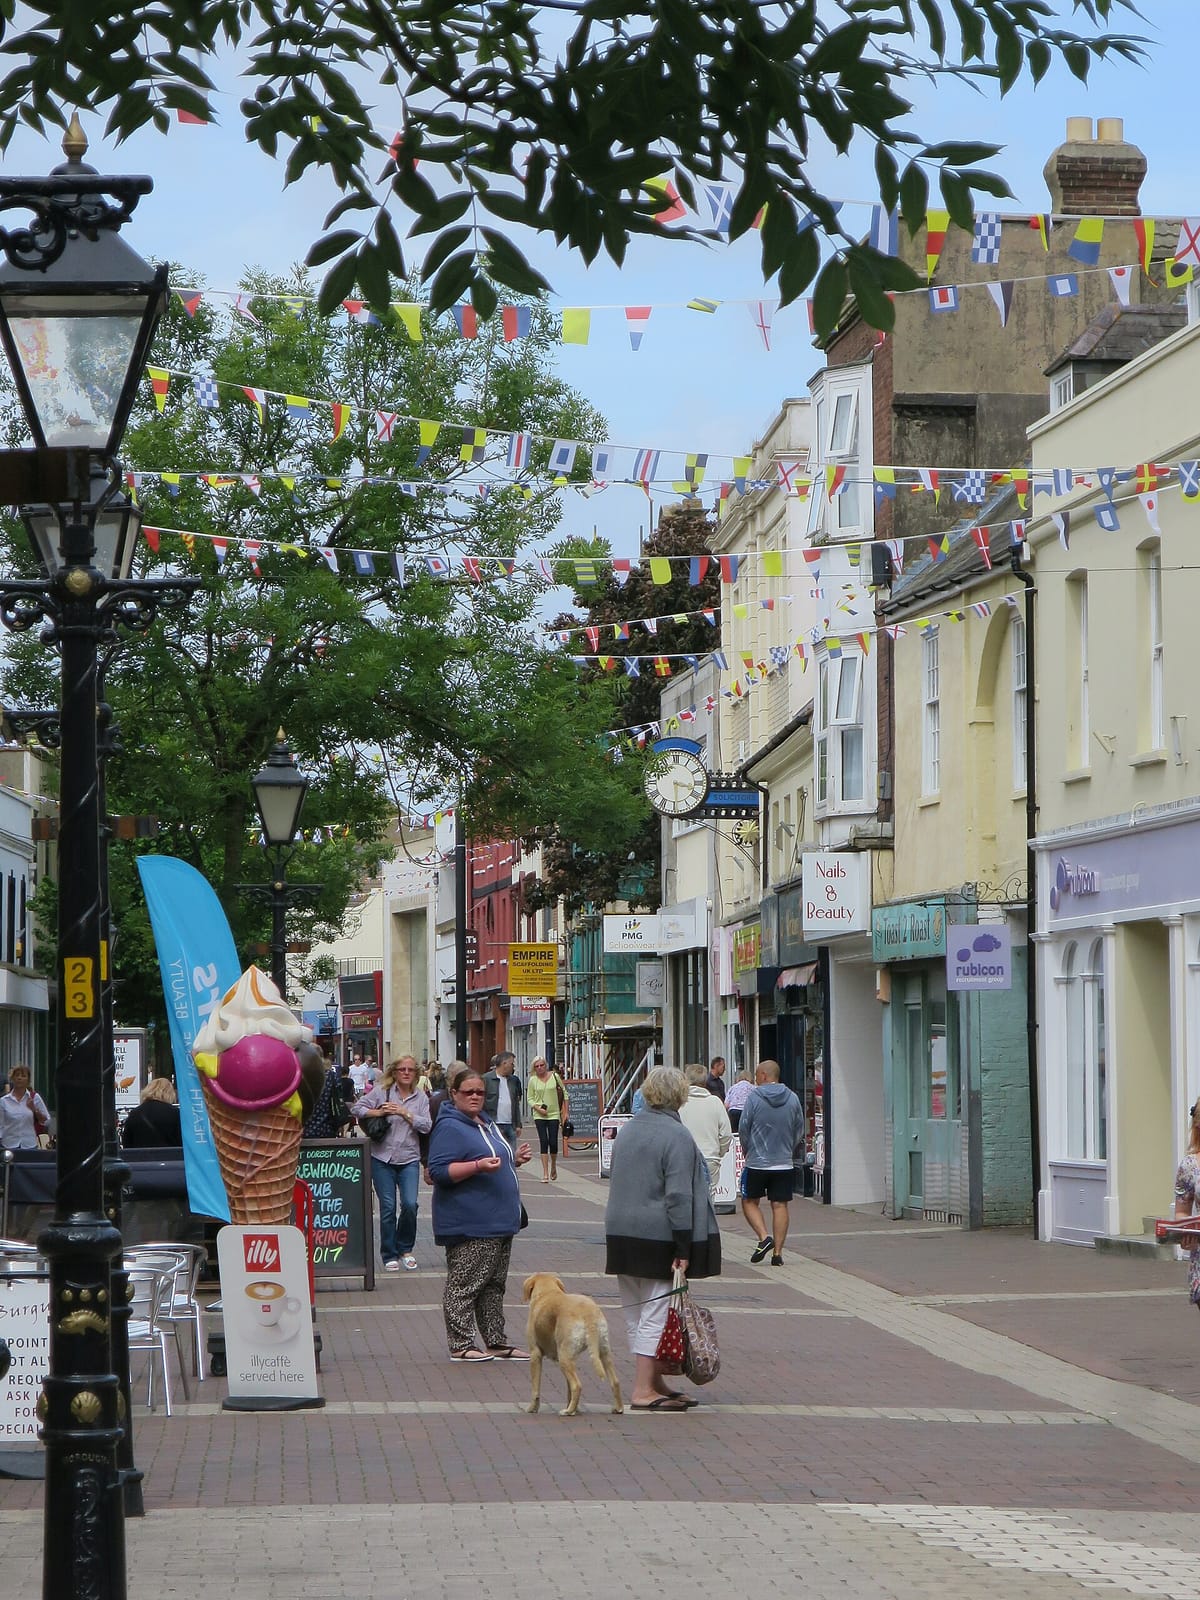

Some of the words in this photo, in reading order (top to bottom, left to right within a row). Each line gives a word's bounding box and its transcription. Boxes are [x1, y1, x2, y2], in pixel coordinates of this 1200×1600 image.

[816, 861, 846, 878] Nails
[825, 885, 837, 901] &
[807, 902, 855, 923] Beauty
[621, 932, 643, 940] PMG
[883, 917, 901, 945] Toast
[902, 914, 908, 943] 2
[910, 912, 930, 942] Roast
[512, 951, 554, 960] EMPIRE
[956, 963, 1004, 976] rubicon
[306, 1150, 334, 1159] DORSET
[336, 1149, 361, 1158] CAMRA
[295, 1163, 361, 1183] REWHOUSE
[318, 1198, 343, 1213] THE
[247, 1239, 277, 1269] illy
[305, 1246, 343, 1264] 017
[10, 1357, 25, 1367] OT
[251, 1355, 291, 1370] illycaffè
[9, 1375, 43, 1386] REQU
[239, 1371, 276, 1382] served
[279, 1371, 304, 1382] here
[6, 1391, 30, 1401] ASK
